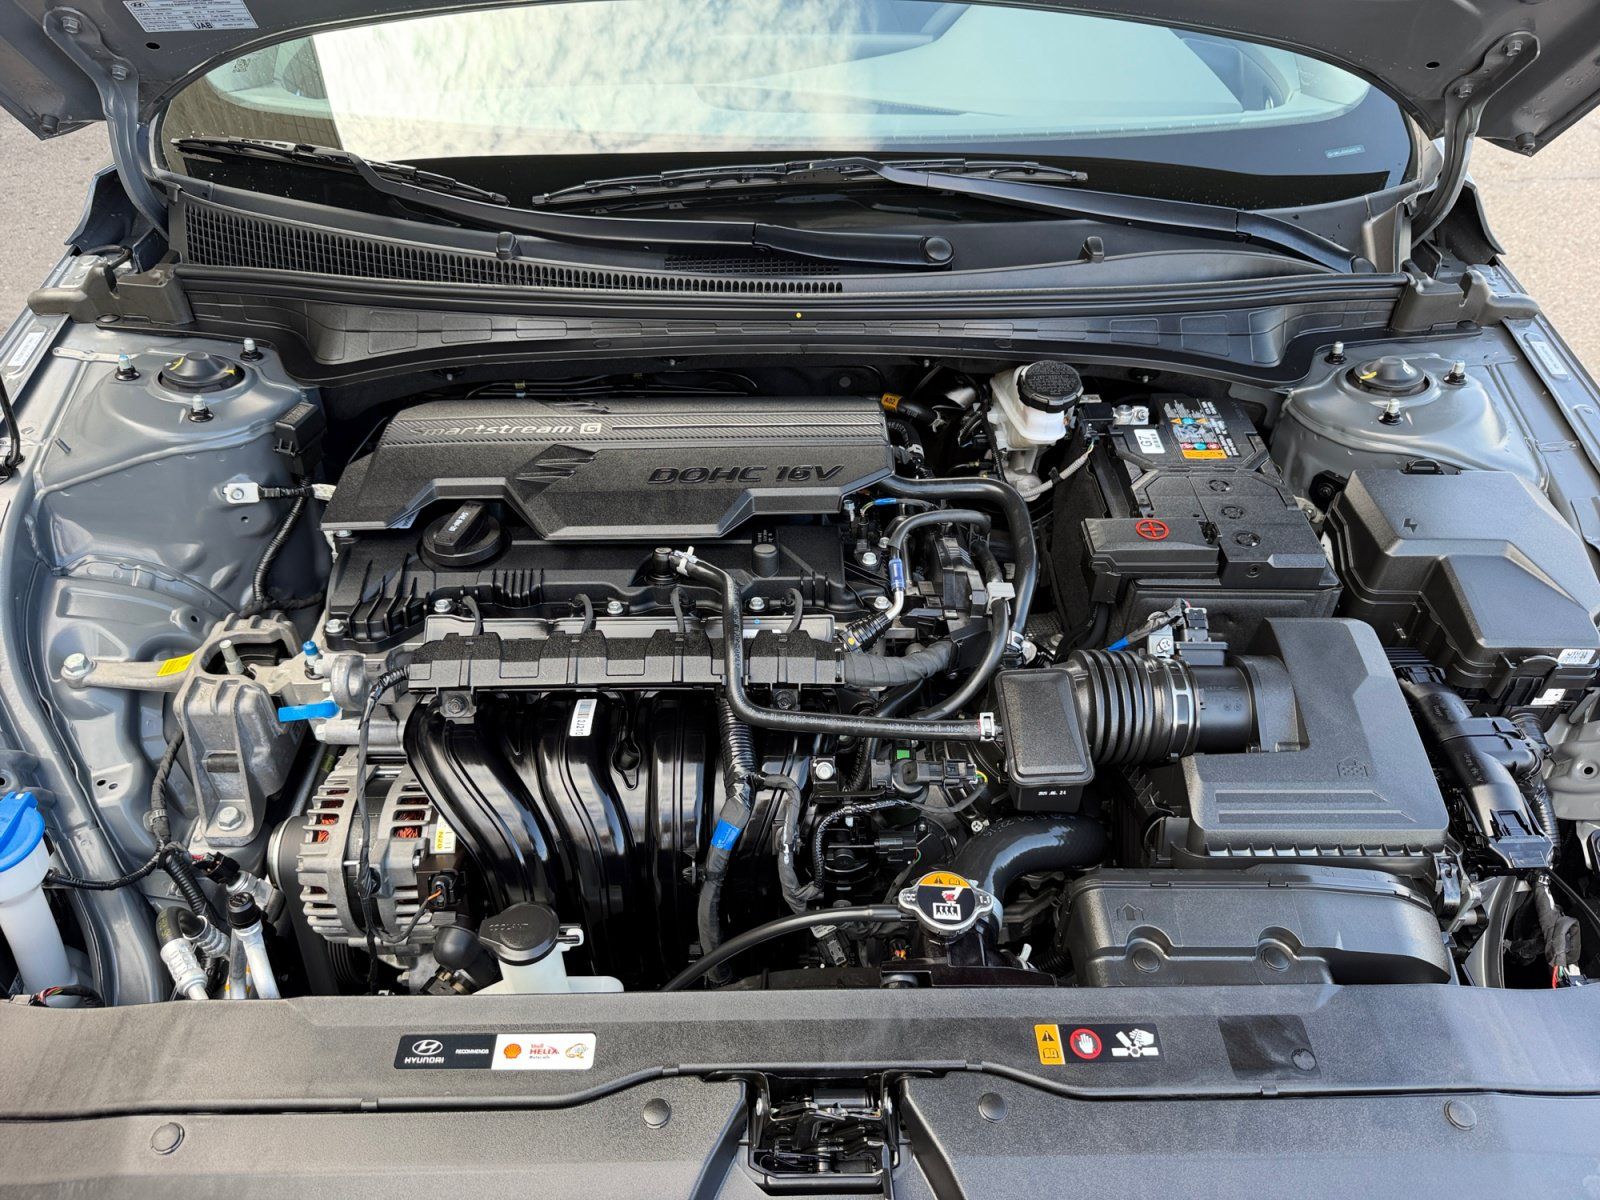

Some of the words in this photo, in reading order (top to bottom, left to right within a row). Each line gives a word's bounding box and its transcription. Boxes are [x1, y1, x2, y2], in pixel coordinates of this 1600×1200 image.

[411, 424, 574, 436] Smartstream
[1138, 435, 1153, 447] G7
[648, 465, 768, 484] DOHC
[775, 464, 845, 482] 16V
[404, 1056, 445, 1064] HYUNDAI
